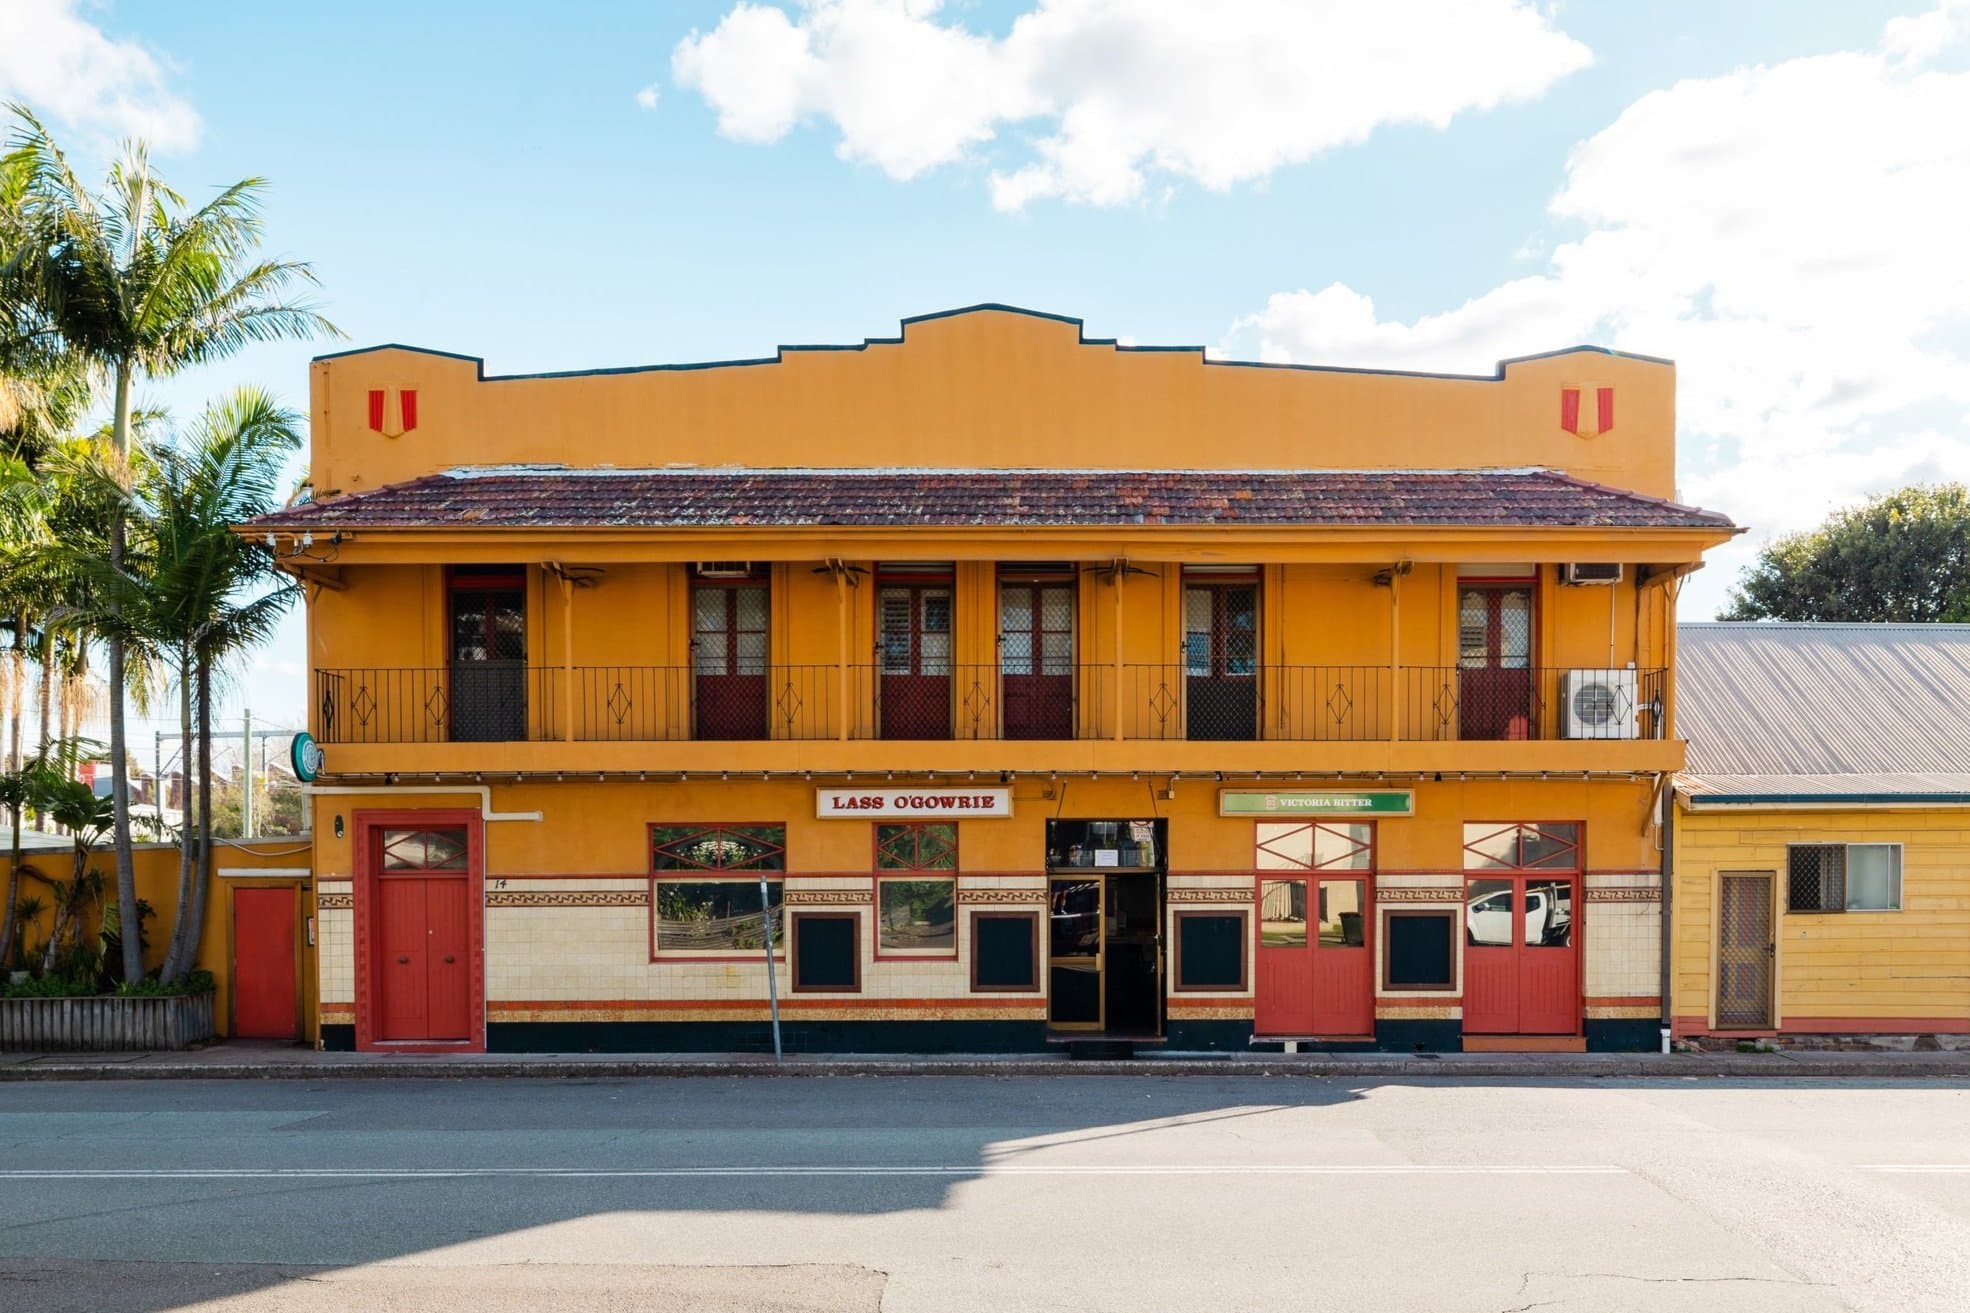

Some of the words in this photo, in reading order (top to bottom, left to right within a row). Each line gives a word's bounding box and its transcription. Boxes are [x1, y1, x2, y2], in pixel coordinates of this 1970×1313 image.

[832, 796, 884, 809] LASS
[894, 795, 995, 809] O'GOWRIE
[1280, 798, 1331, 807] VICTORIA
[1333, 798, 1373, 807] BITTER
[495, 879, 506, 889] 14
